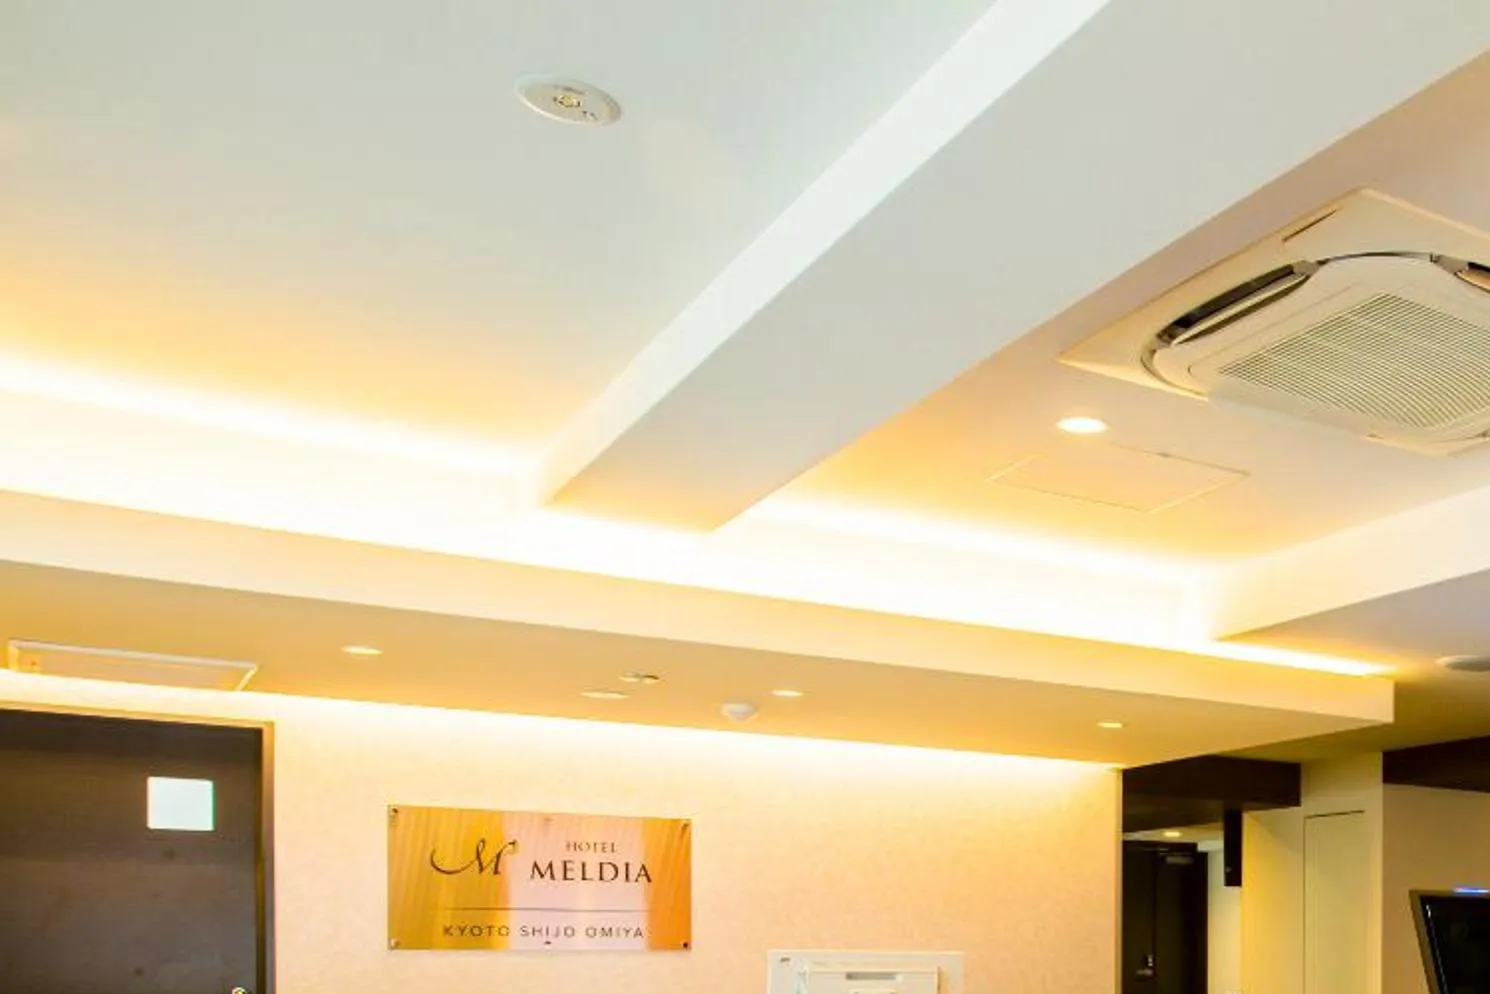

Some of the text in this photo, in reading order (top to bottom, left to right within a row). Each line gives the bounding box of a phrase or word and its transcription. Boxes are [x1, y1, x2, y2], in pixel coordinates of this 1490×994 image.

[566, 841, 618, 853] HOTEL
[530, 860, 653, 883] MELDIA
[443, 925, 645, 938] KYOTO SHIJO OMIYA
